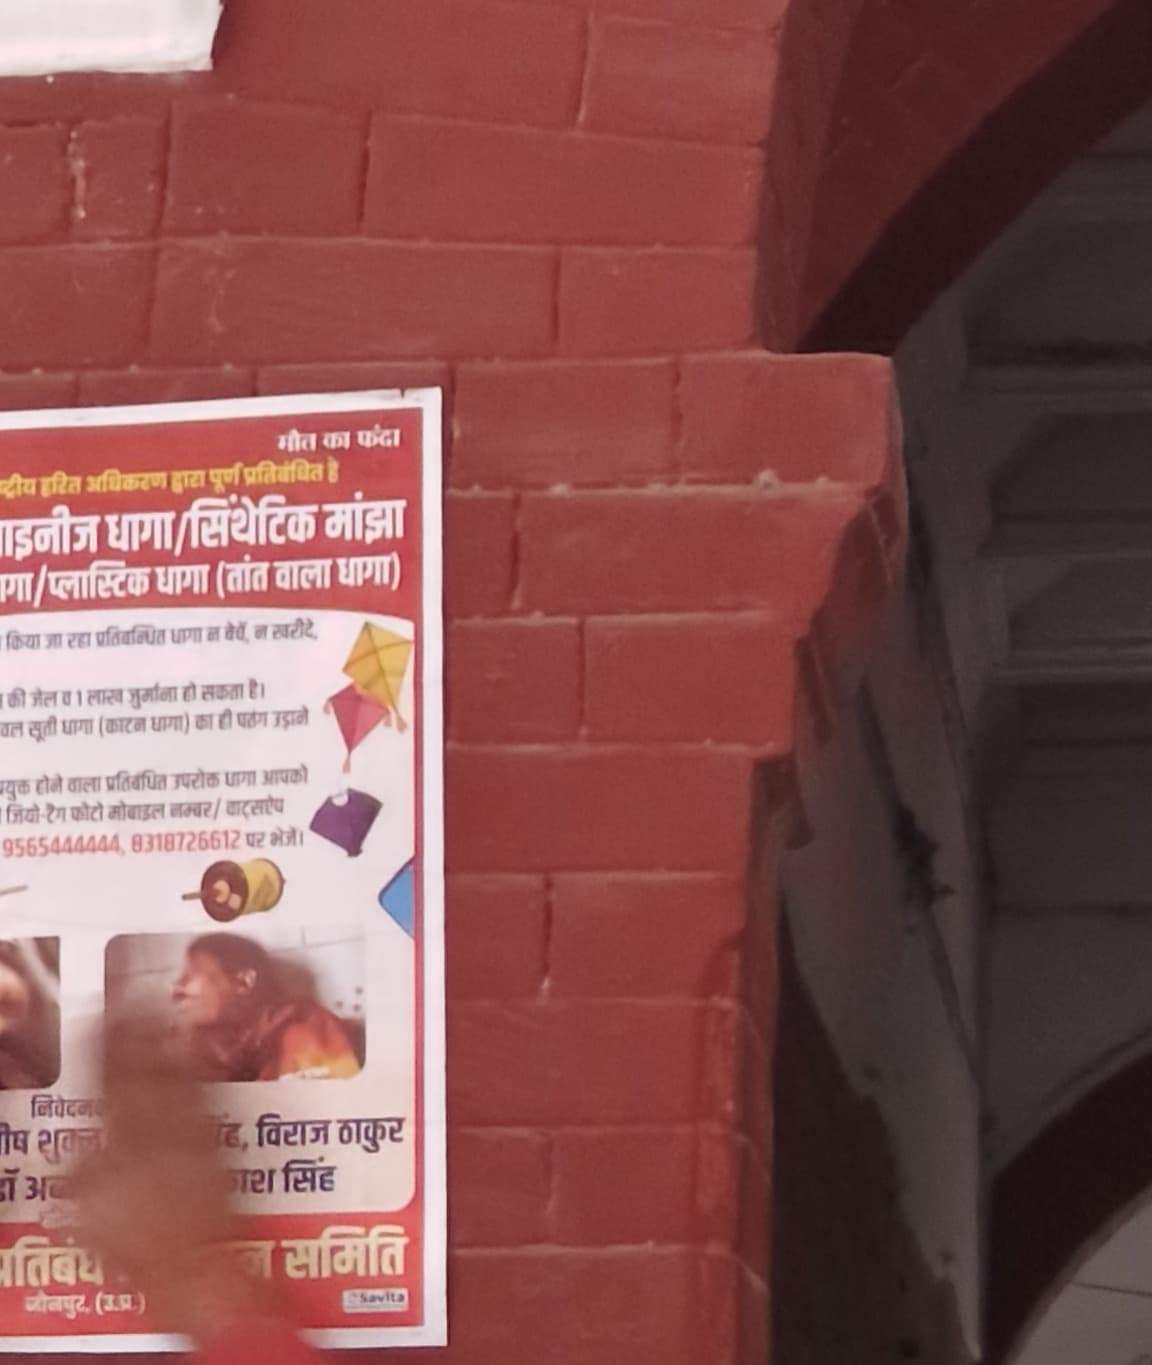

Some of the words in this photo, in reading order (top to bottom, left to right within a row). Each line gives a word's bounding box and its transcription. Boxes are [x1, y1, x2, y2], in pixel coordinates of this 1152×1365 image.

[322, 429, 350, 450] का
[357, 424, 400, 448] फंदा
[40, 470, 79, 496] हरित
[85, 469, 166, 494] अधिकरण
[170, 469, 206, 494] द्वारा
[208, 462, 241, 494] पूर्ण
[243, 458, 324, 486] प्रतिबंधित
[105, 492, 319, 557] धागा/सिंथेटिक
[322, 491, 407, 545] मांझा
[155, 563, 210, 596] धागा
[216, 553, 270, 599] (तांत
[272, 557, 333, 591] वाला
[337, 551, 402, 592] धागा)
[6, 630, 41, 650] किया
[45, 631, 62, 649] जा
[67, 631, 91, 649] रहा
[171, 626, 202, 645] धागा
[207, 626, 220, 642] न
[254, 623, 268, 640] न
[7, 688, 26, 708] की
[31, 688, 57, 708] जेल
[62, 690, 73, 707] व
[87, 687, 123, 706] लाख
[128, 682, 177, 709] जुर्माना
[182, 681, 197, 702] हो
[201, 683, 244, 701] सकता
[28, 715, 57, 741] सूती
[62, 717, 93, 736] धागा
[99, 714, 146, 738] (काटन
[151, 711, 190, 734] धागा)
[195, 713, 213, 731] का
[218, 708, 232, 731] ही
[35, 773, 63, 795] होने
[67, 775, 101, 794] वाला
[224, 769, 257, 788] धागा
[261, 763, 308, 786] आपको
[71, 802, 103, 823] फोटो
[108, 800, 165, 822] मोबाइल
[2, 833, 126, 858] 9565444444,
[131, 829, 241, 854] 8318726612
[246, 830, 265, 849] पर
[256, 1113, 332, 1147] विराज
[336, 1117, 406, 1153] ठाकुर
[282, 1156, 337, 1193] सिंह
[281, 1224, 410, 1279] समिति
